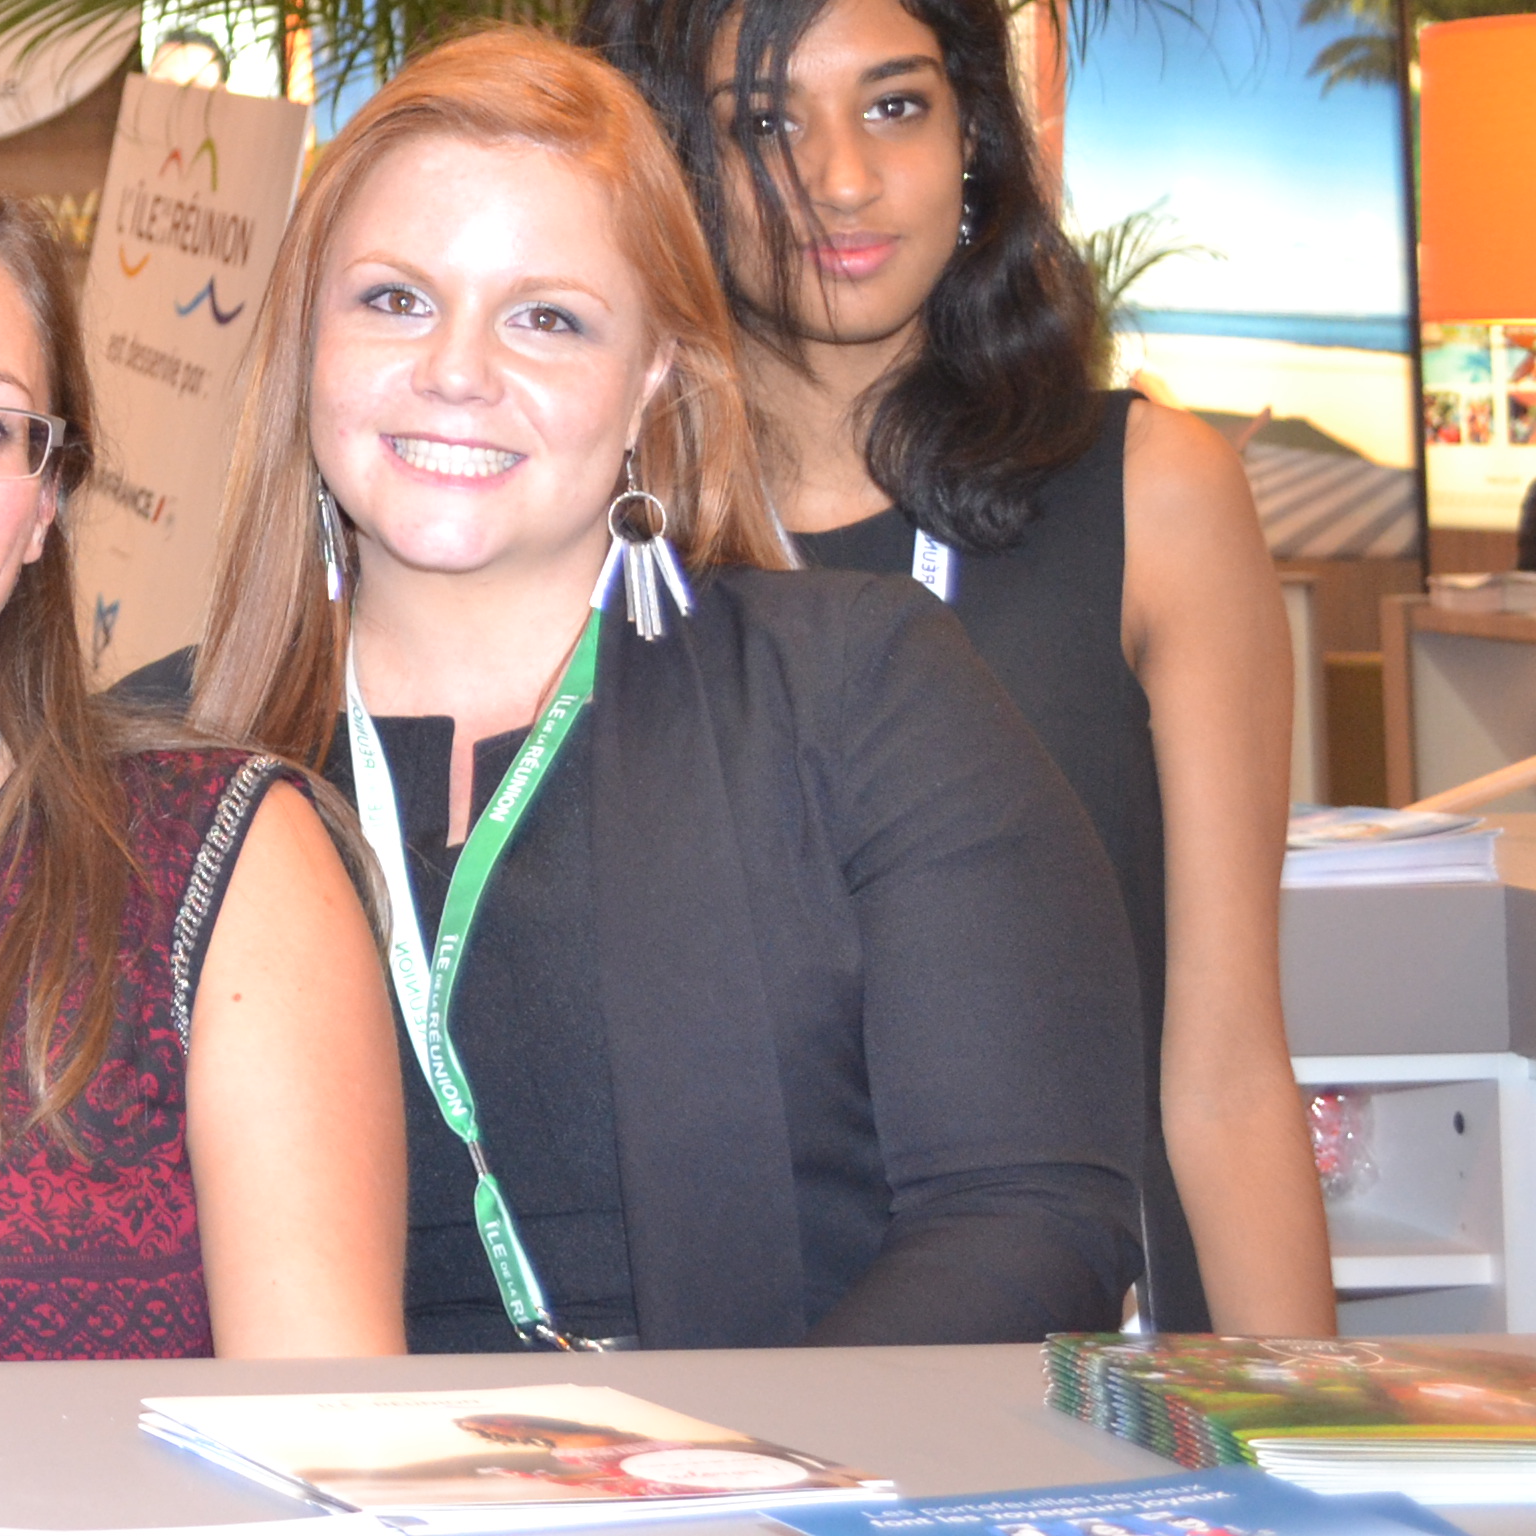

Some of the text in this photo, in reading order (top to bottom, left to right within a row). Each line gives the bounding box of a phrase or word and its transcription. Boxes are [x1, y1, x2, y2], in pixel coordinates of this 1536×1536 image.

[548, 693, 580, 720] ÎLE
[488, 743, 545, 823] RÉUNION
[435, 932, 460, 971] ÎLE
[427, 1011, 469, 1118] RÉUNION
[485, 1221, 506, 1258] ÎLE
[860, 1508, 916, 1519] Les
[934, 1513, 982, 1524] les
[983, 1502, 1133, 1521] voyageurs
